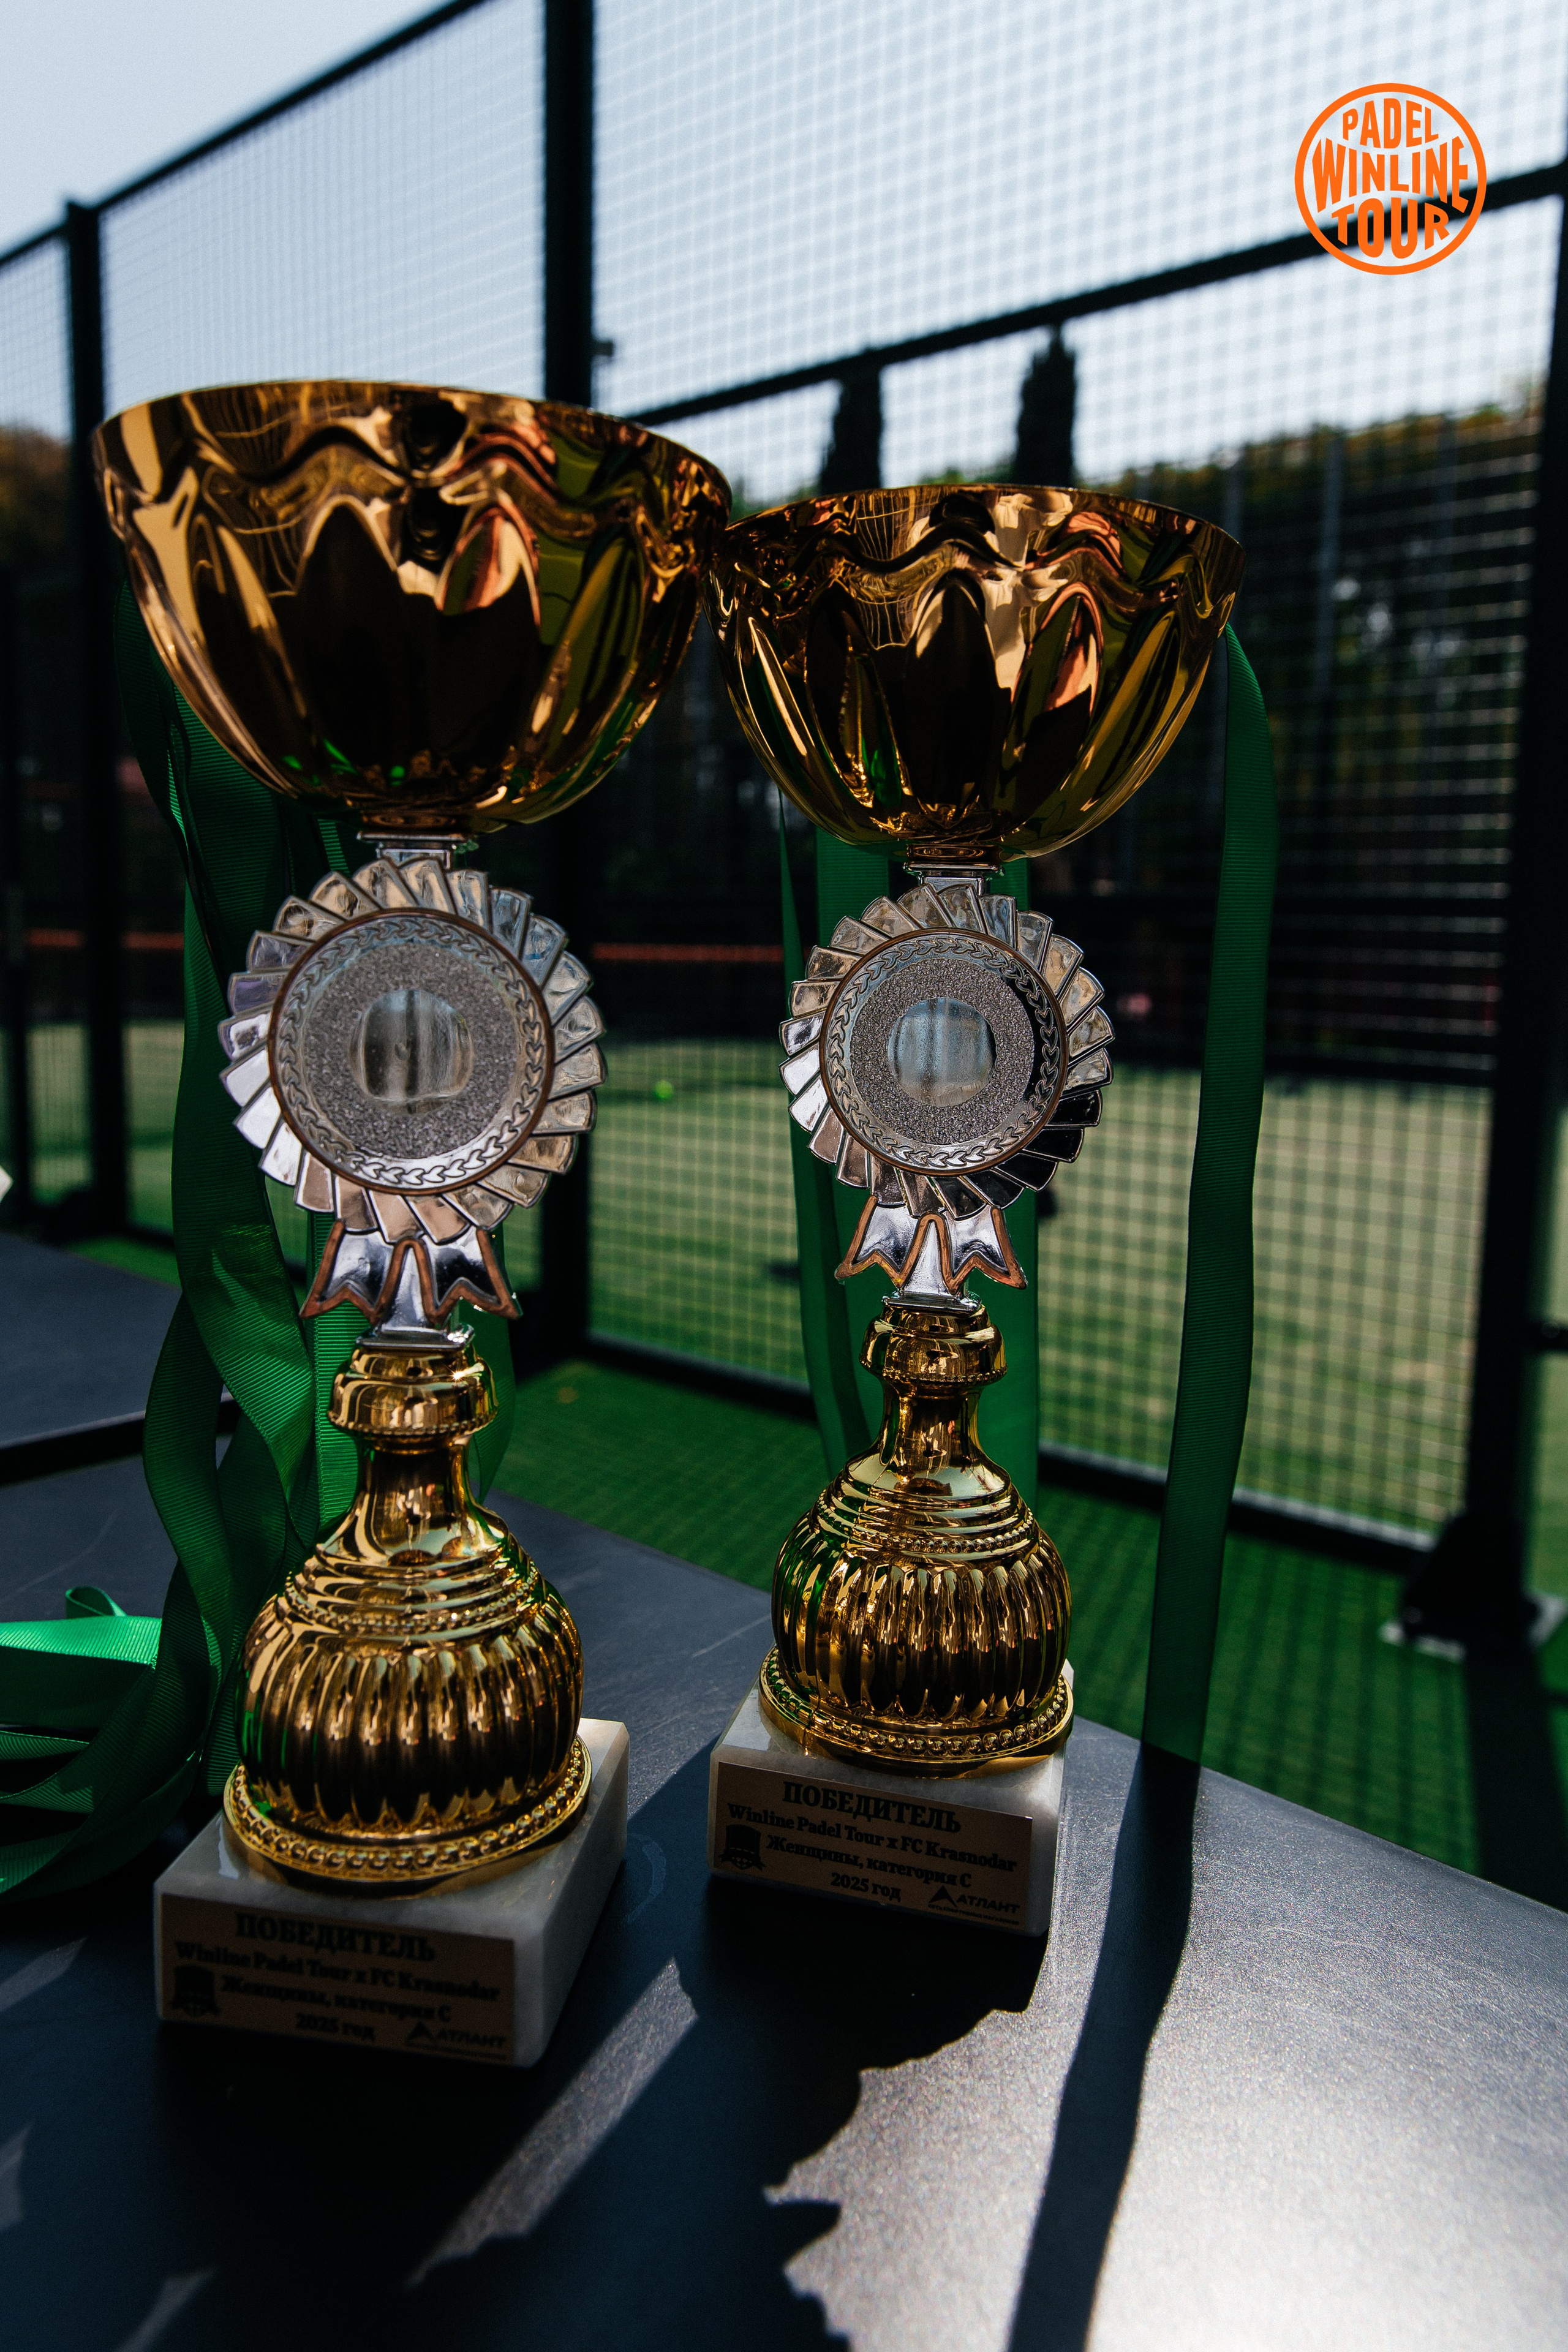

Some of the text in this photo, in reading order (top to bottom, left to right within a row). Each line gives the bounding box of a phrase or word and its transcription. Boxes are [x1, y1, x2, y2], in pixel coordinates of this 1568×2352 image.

[783, 1781, 961, 1833] ПОБЕДИТЕЛЬ
[727, 1803, 794, 1829] Winline
[797, 1817, 841, 1838] Padel
[845, 1826, 884, 1848] Tour
[900, 1839, 924, 1855] FC
[925, 1842, 1017, 1872] Krasnodar
[766, 1835, 864, 1869] Женщины,
[866, 1858, 957, 1887] категория
[831, 1872, 901, 1902] 2025 год
[956, 1894, 1020, 1914] АТЛАНТ
[236, 1912, 435, 1962] ПОБЕДИТЕЛЬ
[176, 1940, 251, 1967] Winline
[253, 1951, 304, 1975] Padel
[307, 1959, 352, 1980] Tour
[370, 1967, 396, 1986] FC
[398, 1970, 500, 2002] Krasnodar
[221, 1974, 331, 2008] Женщины,
[334, 1994, 435, 2021] категория
[296, 2013, 376, 2041] 2025 год
[436, 2028, 507, 2048] АТЛАНТ
